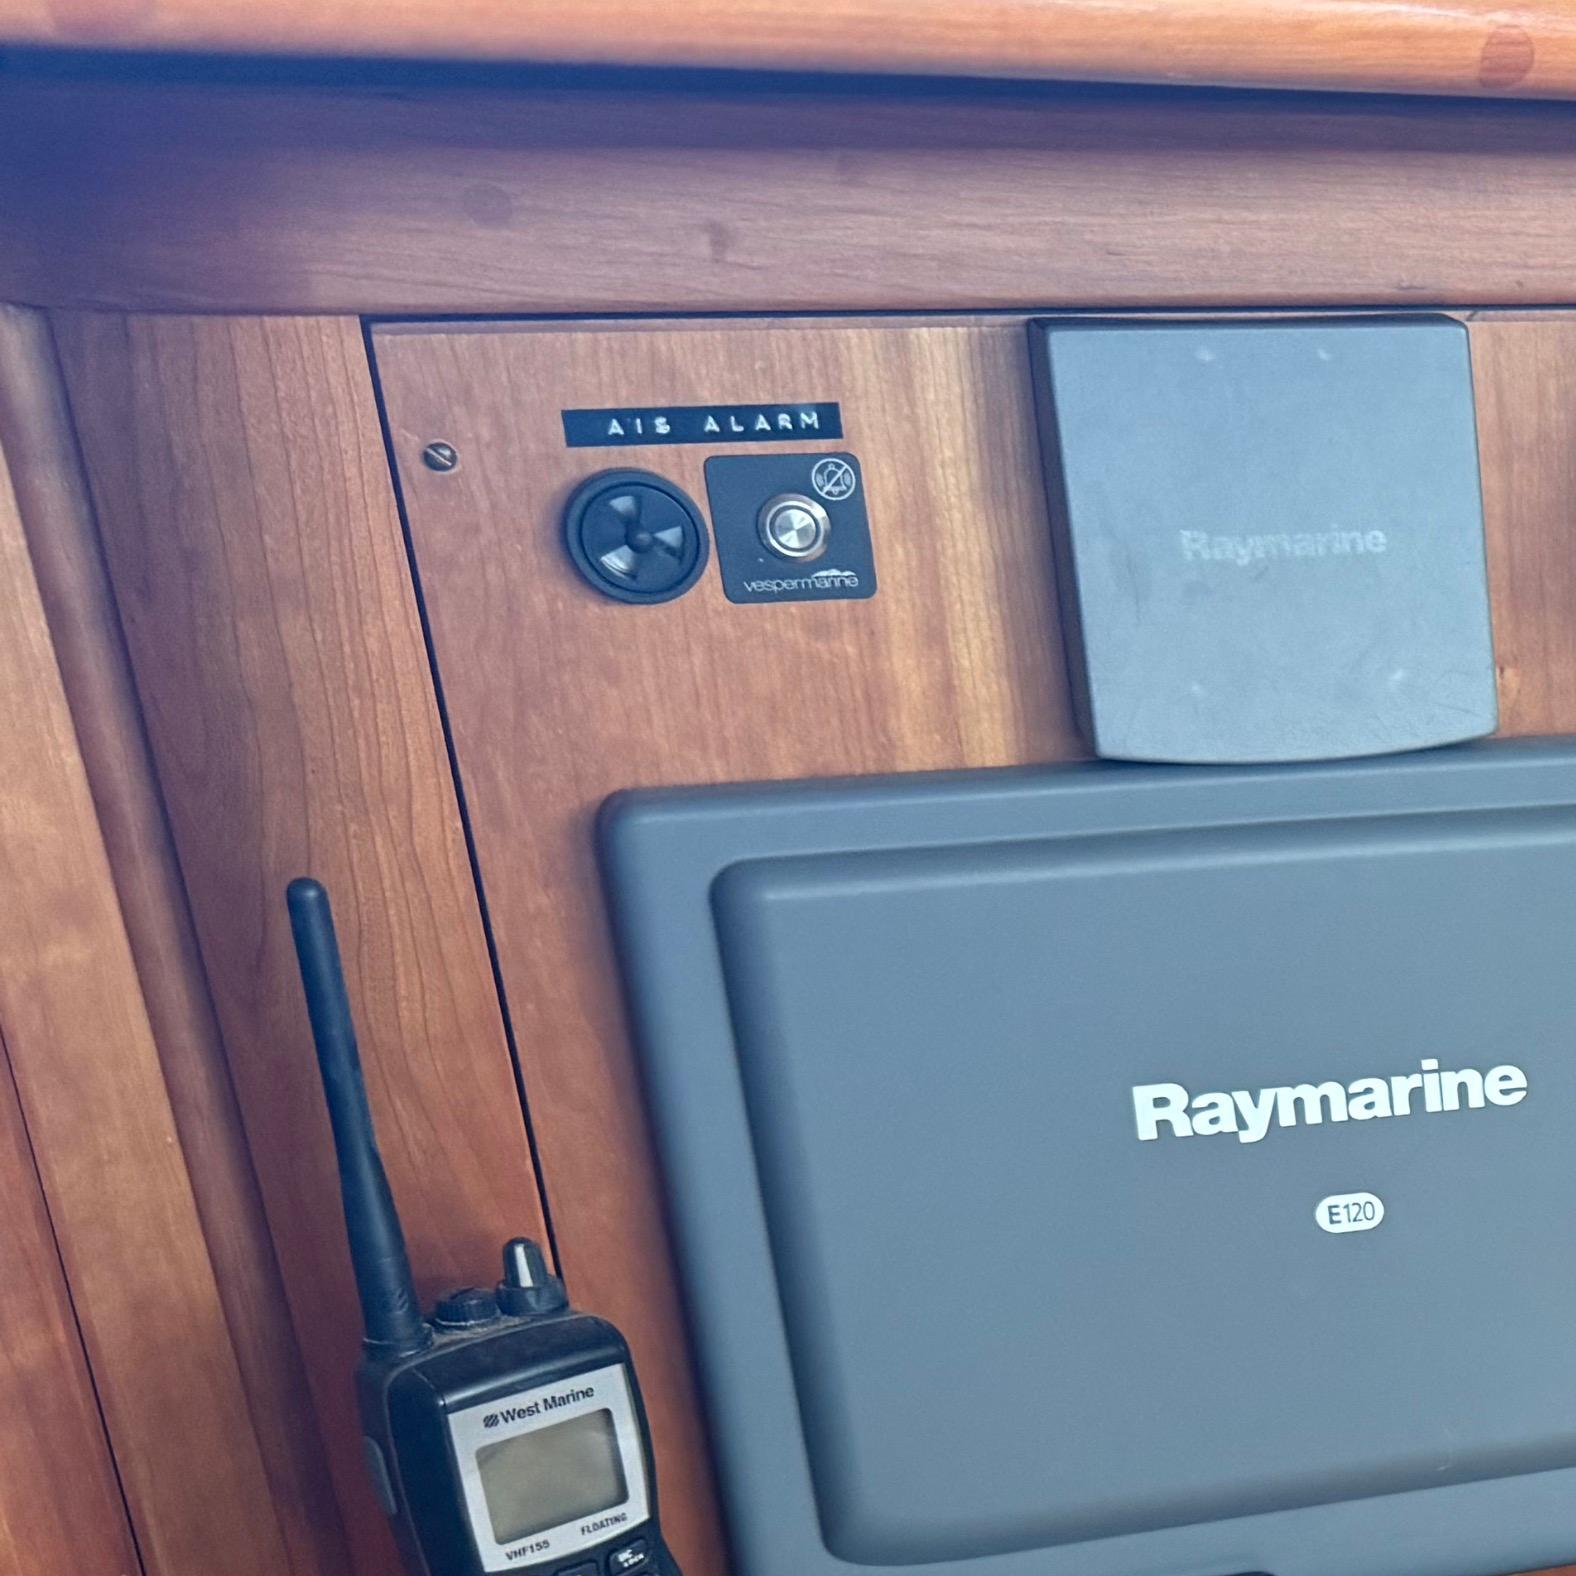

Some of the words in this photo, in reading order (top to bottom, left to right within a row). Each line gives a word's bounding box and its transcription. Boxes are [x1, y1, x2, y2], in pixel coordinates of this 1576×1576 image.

[608, 417, 671, 435] AIS
[704, 411, 819, 433] ALARM
[1181, 525, 1387, 566] Raymarine
[744, 573, 858, 593] vespermarine
[1132, 1058, 1527, 1144] Raymarine
[1327, 1200, 1376, 1225] E120
[500, 1403, 541, 1424] West
[543, 1386, 594, 1412] Marine
[581, 1513, 627, 1536] FLOATING
[505, 1539, 550, 1561] VHF155
